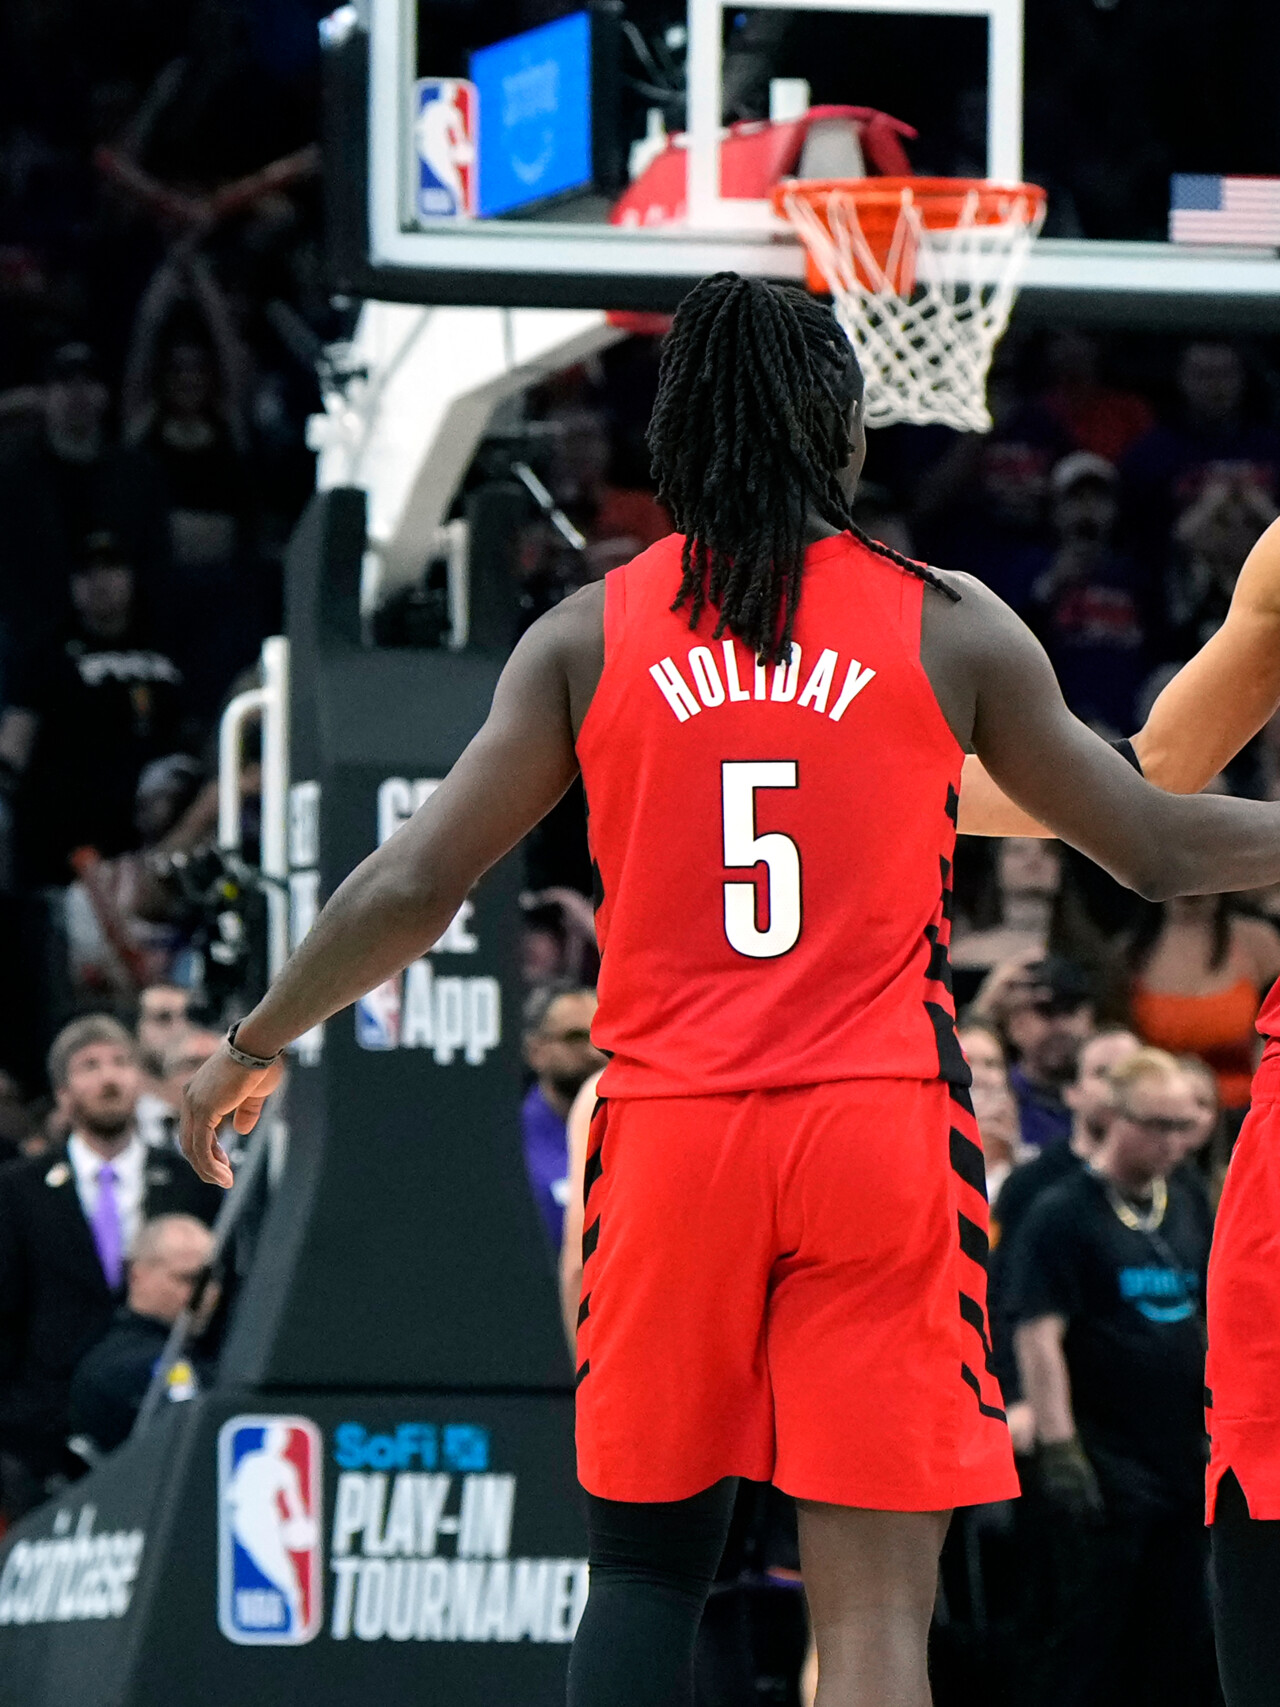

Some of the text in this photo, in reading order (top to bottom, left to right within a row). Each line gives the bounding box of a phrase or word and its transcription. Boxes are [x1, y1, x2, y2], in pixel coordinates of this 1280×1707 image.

[648, 639, 877, 722] HOLIDAY
[720, 759, 802, 960] 5
[402, 959, 500, 1065] App
[334, 1422, 438, 1469] SoFi
[332, 1472, 517, 1557] PLAY-IN
[331, 1556, 590, 1643] TOURNAME
